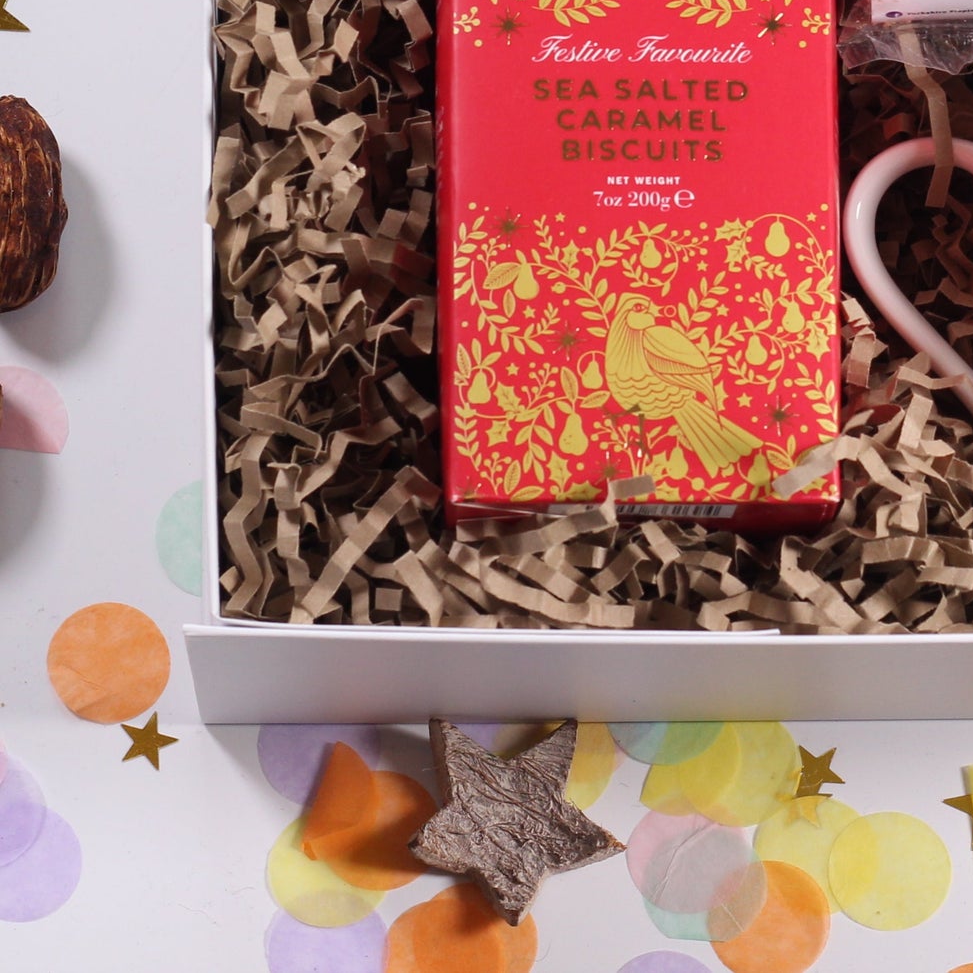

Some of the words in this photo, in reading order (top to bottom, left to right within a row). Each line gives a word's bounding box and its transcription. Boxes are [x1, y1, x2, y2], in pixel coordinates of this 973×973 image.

[532, 34, 622, 64] Festive
[628, 34, 753, 64] Favourite
[532, 79, 599, 101] SEA
[614, 79, 749, 102] SALTED
[556, 109, 727, 132] CARAMEL
[561, 139, 725, 162] BISCUITS
[606, 176, 630, 185] NET
[634, 176, 680, 185] WEIGHT
[593, 190, 622, 207] 7oz
